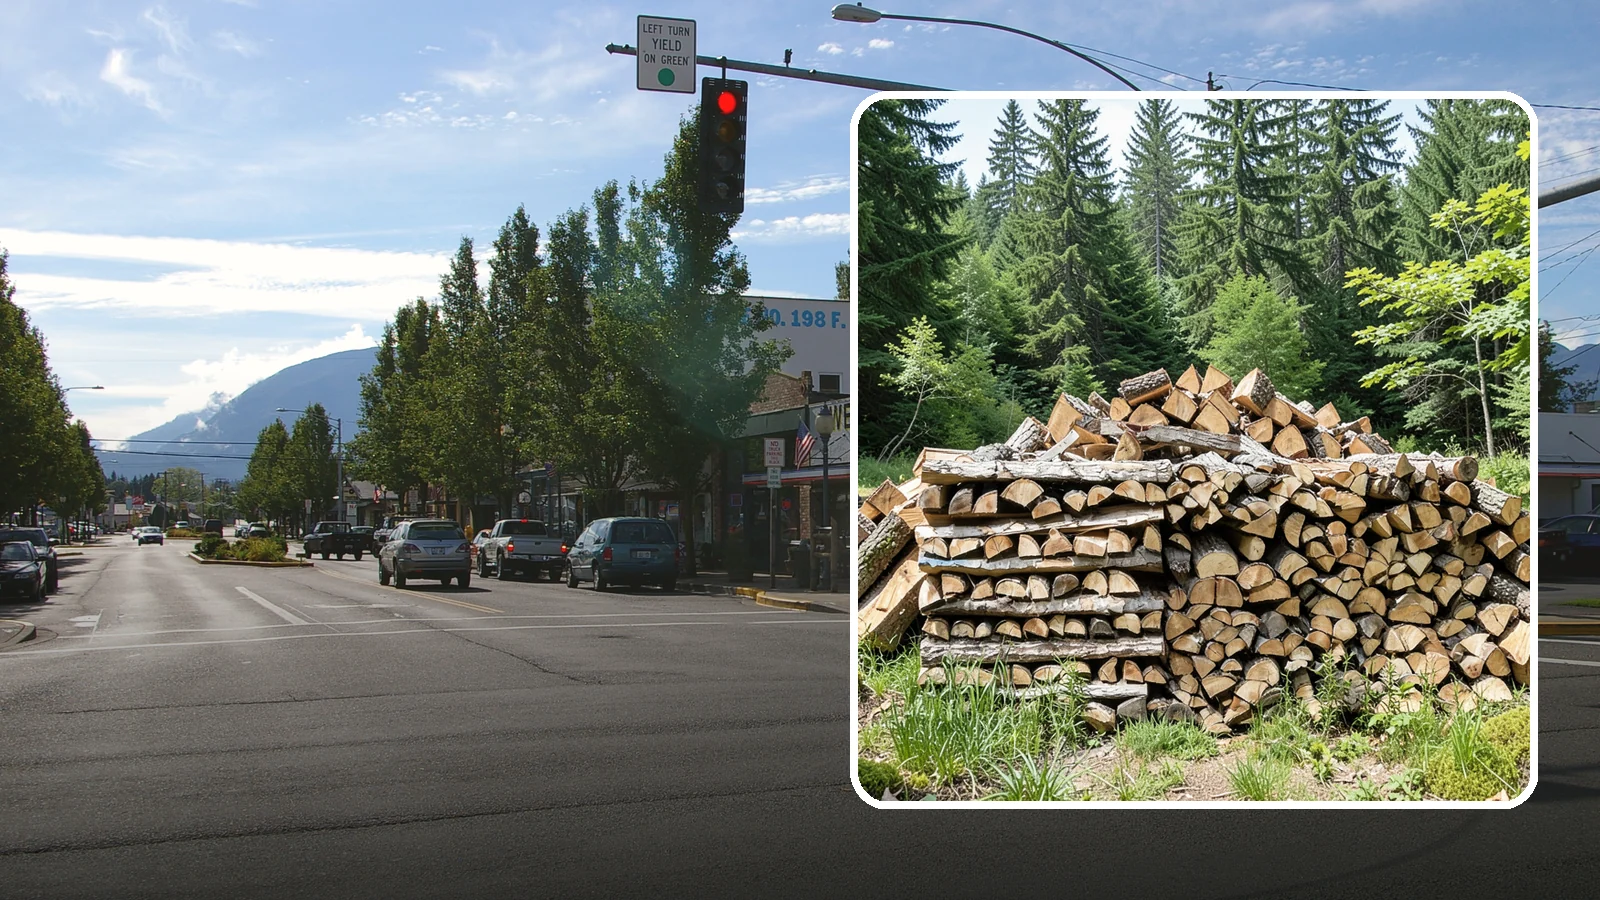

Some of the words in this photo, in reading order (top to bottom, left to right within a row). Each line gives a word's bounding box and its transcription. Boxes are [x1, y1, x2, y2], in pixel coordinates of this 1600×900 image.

[643, 24, 663, 34] LEFT
[668, 26, 690, 36] TURN
[652, 38, 682, 51] YIELD
[644, 53, 656, 63] ON
[661, 55, 688, 66] GREEN
[791, 309, 826, 328] 198
[831, 311, 846, 329] F.
